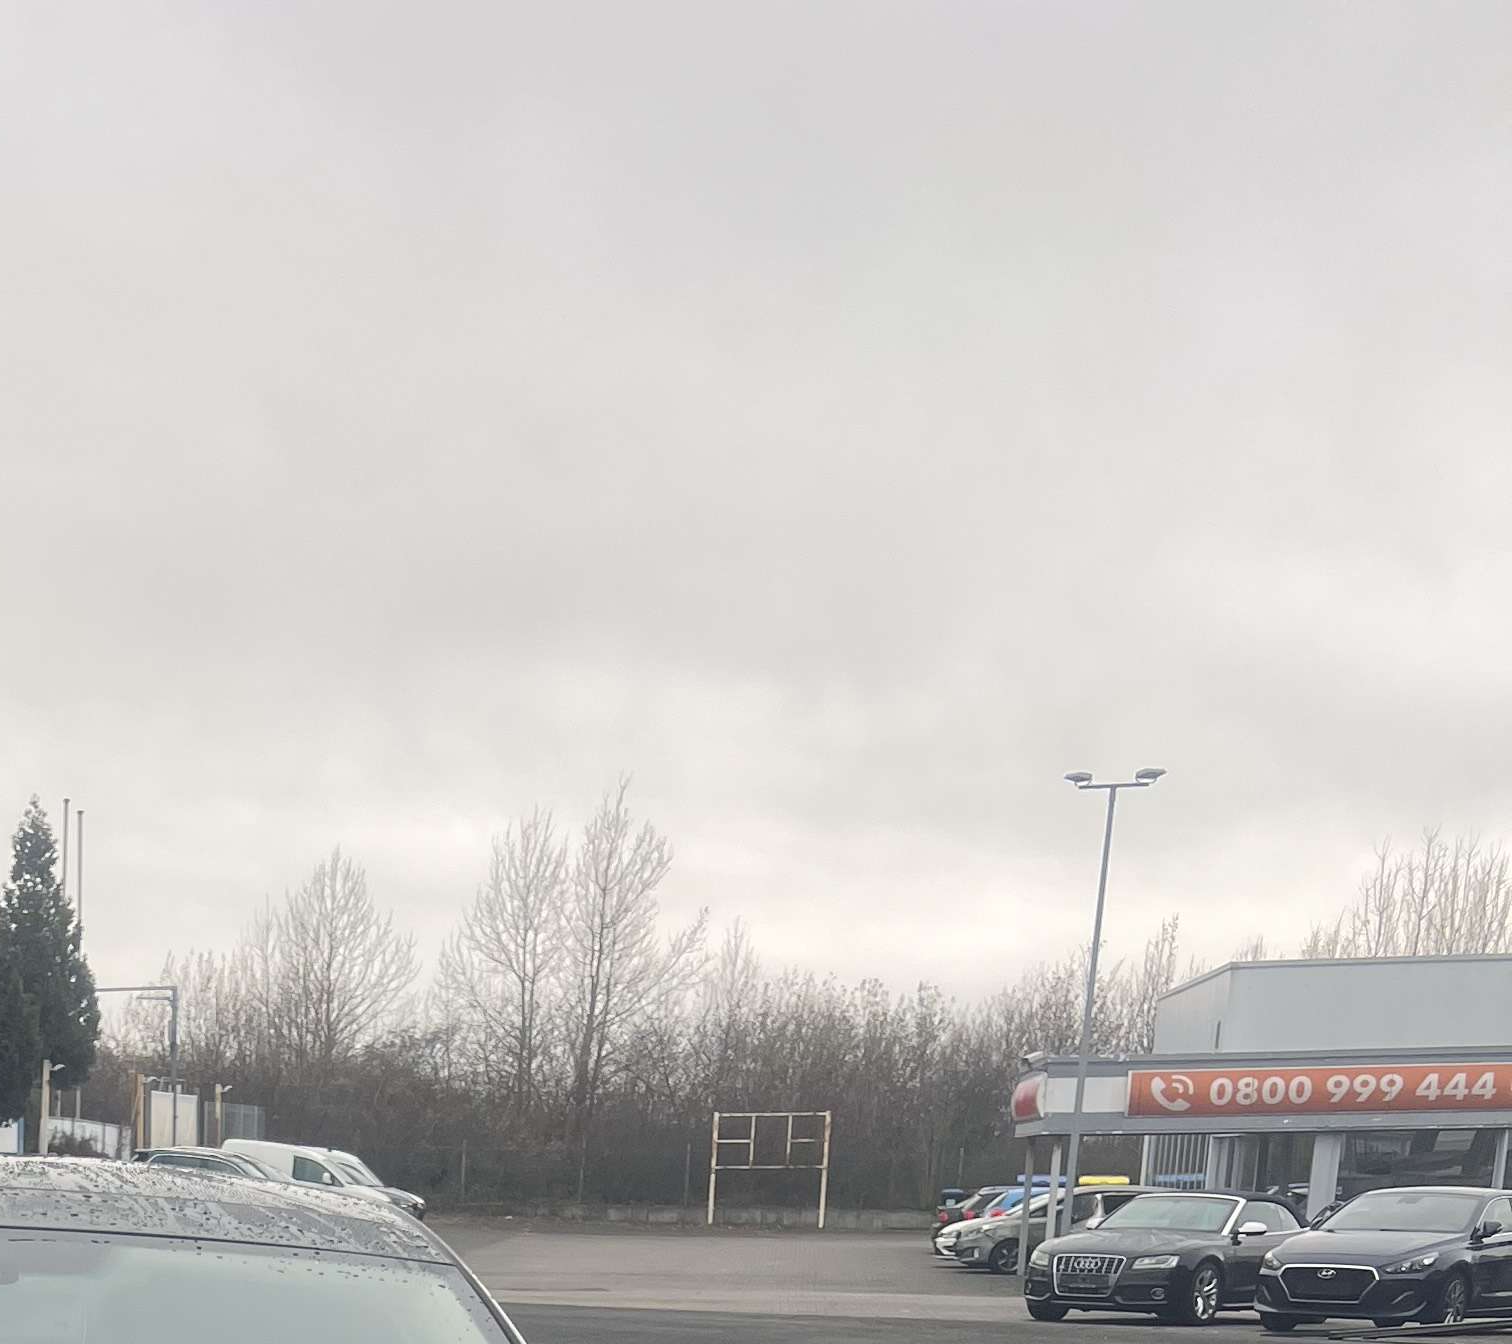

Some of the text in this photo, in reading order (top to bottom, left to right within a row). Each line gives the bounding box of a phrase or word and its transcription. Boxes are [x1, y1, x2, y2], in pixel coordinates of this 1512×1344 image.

[1209, 1071, 1498, 1106] 0800 999 444
